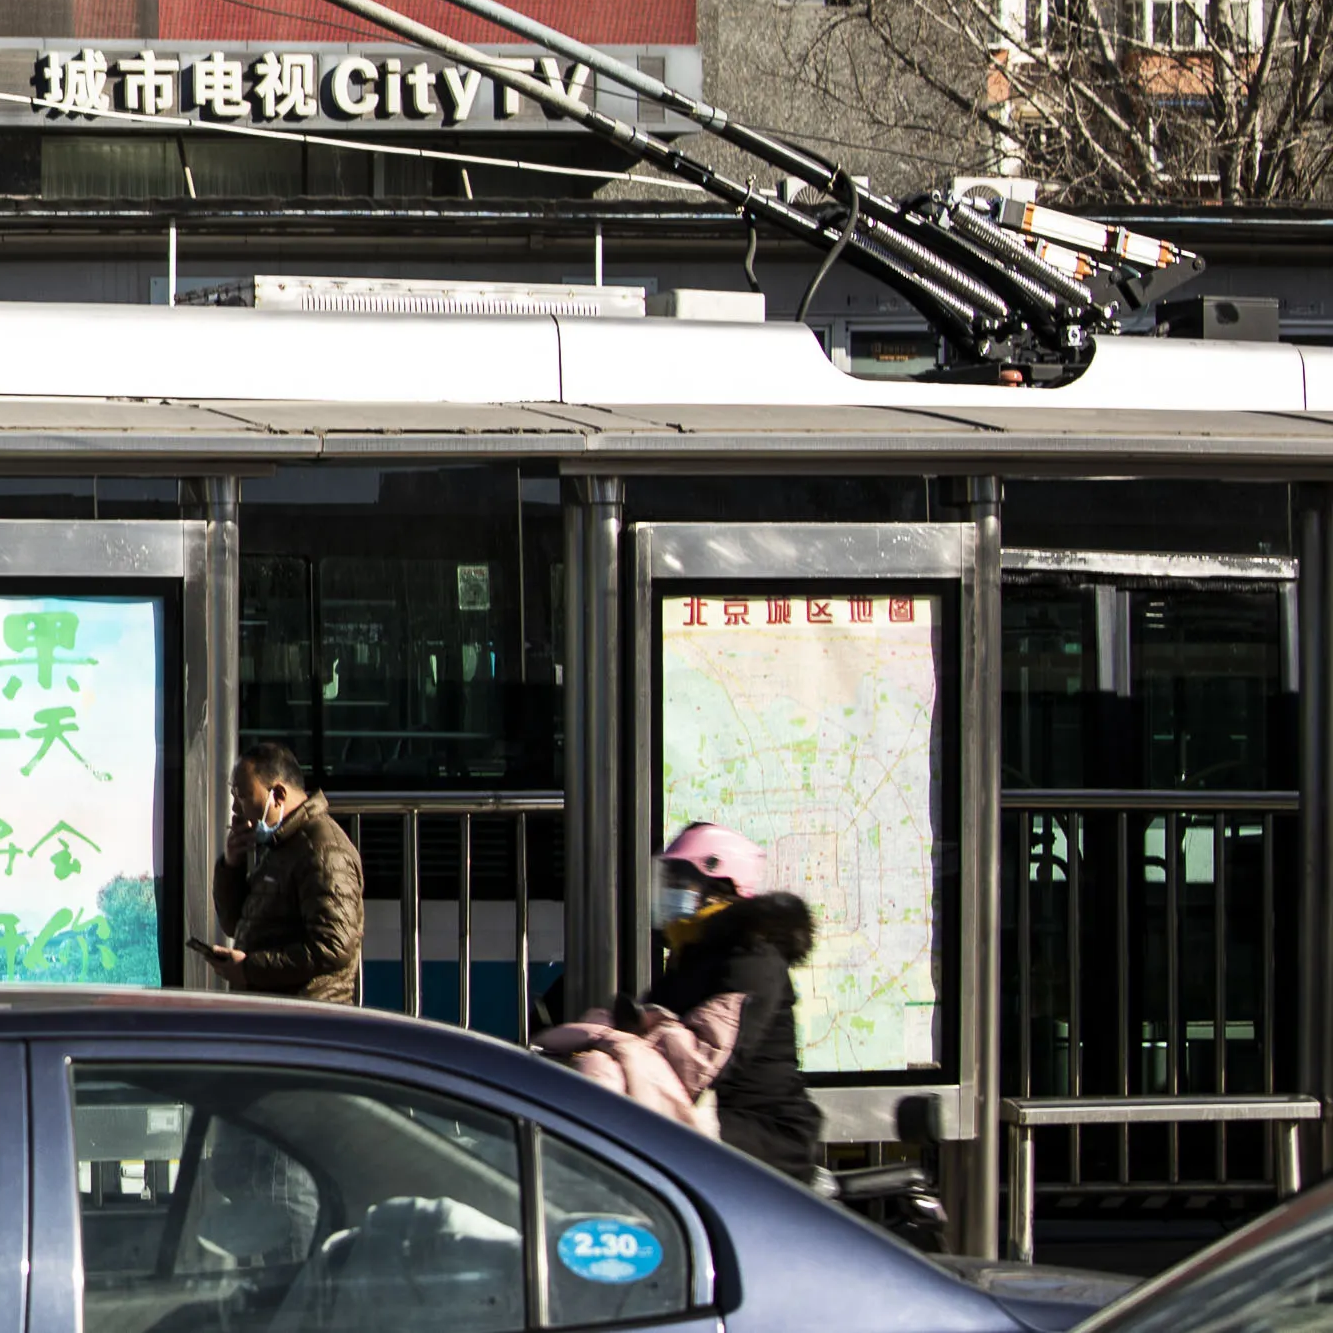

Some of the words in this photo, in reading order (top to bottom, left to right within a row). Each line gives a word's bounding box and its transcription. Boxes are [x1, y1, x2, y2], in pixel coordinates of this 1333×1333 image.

[44, 48, 316, 116] 城市电视
[683, 596, 915, 625] 北京城区地图
[574, 1232, 638, 1258] 2.30
